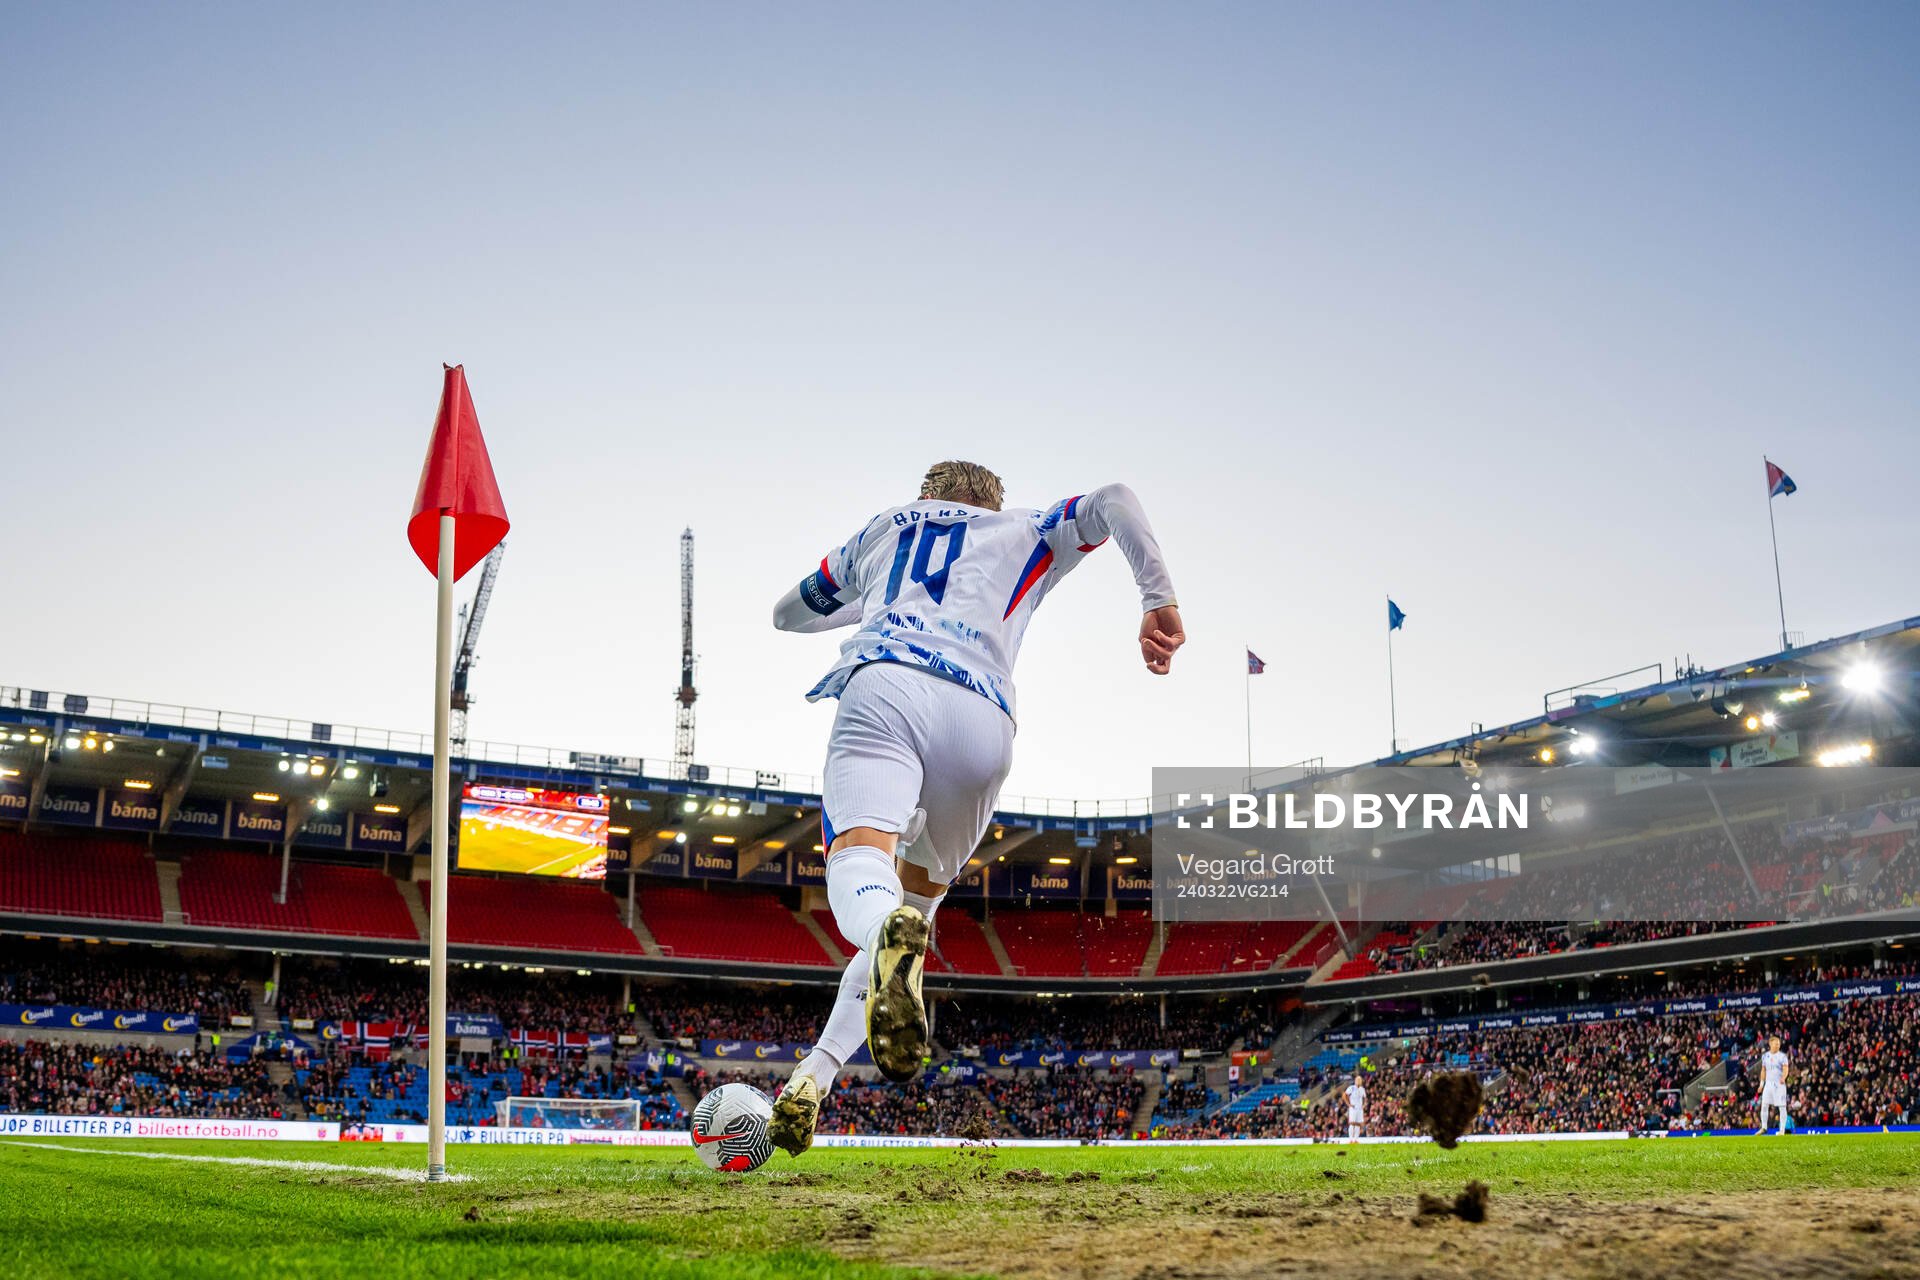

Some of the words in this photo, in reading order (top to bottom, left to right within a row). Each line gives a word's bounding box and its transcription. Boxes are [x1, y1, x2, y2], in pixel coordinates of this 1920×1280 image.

[884, 519, 968, 606] 10
[808, 574, 830, 607] RESPECT
[111, 801, 158, 821] bama
[238, 812, 283, 832] bama
[308, 822, 342, 837] ama
[360, 824, 402, 842] bama
[695, 853, 733, 871] bama
[798, 862, 826, 877] bam
[1031, 874, 1069, 889] bama
[1118, 876, 1156, 889] bama
[1782, 993, 1798, 1001] Norsk
[1799, 991, 1819, 1001] Tipping
[1842, 987, 1859, 996] Norsk
[1860, 985, 1881, 996] Tipping
[1688, 1001, 1706, 1012] Tipping
[1726, 999, 1741, 1007] Norsk
[1742, 996, 1761, 1006] Tipping
[455, 1022, 488, 1036] bama
[647, 1051, 682, 1066] baa
[950, 1066, 973, 1076] ama
[33, 1119, 108, 1135] BILLETTER
[113, 1117, 132, 1135] PÅ
[138, 1122, 278, 1138] billett.fotball.no
[480, 1129, 542, 1145] BILLETTER
